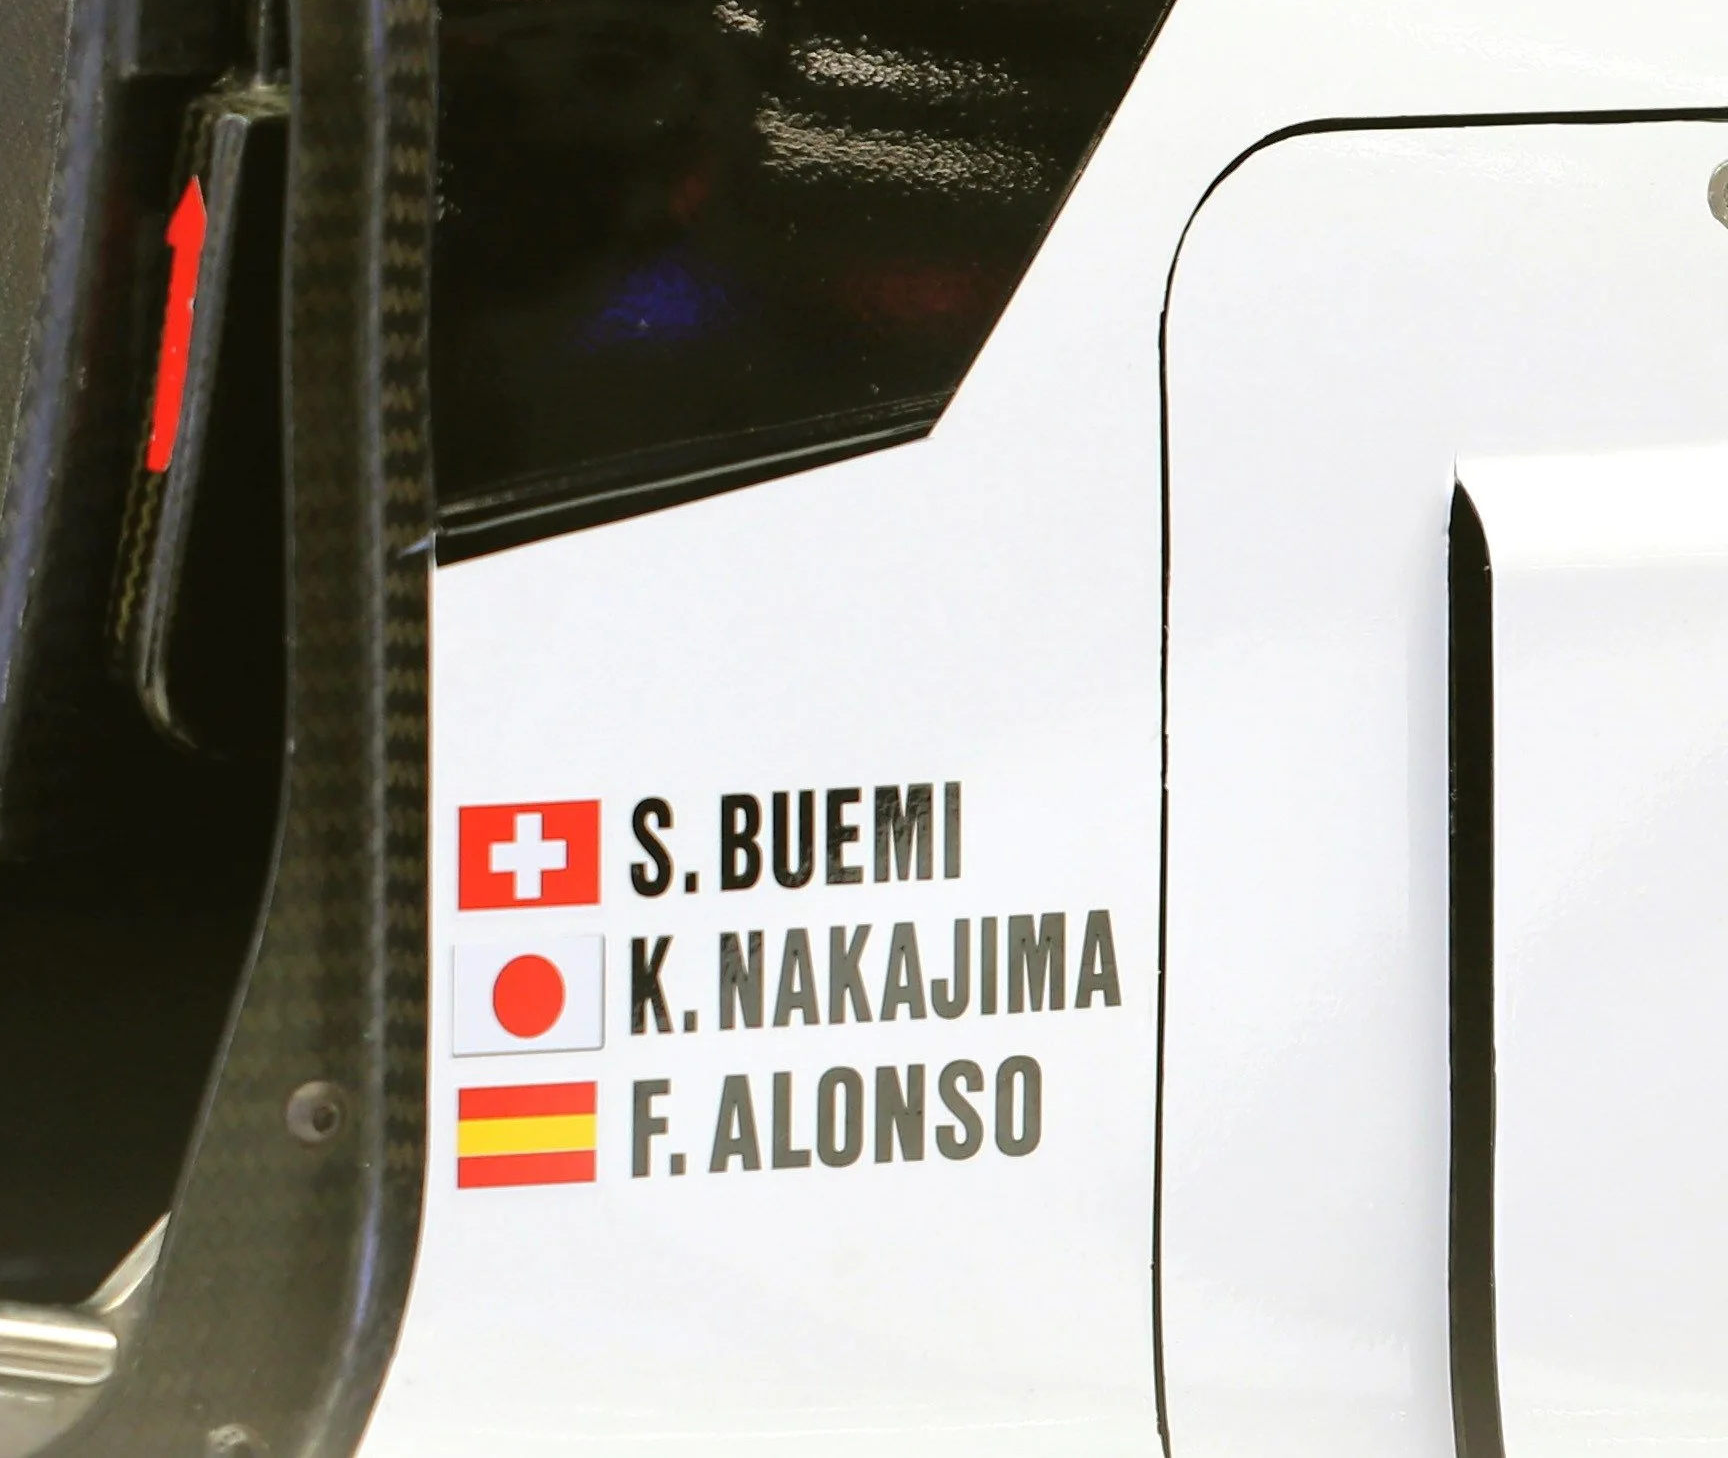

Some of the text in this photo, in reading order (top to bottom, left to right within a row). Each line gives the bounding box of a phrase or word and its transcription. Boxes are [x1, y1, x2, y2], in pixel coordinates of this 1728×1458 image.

[719, 780, 963, 893] BUEMI
[718, 908, 1123, 1030] NAKAJIMA
[708, 1054, 1042, 1174] ALONSO
